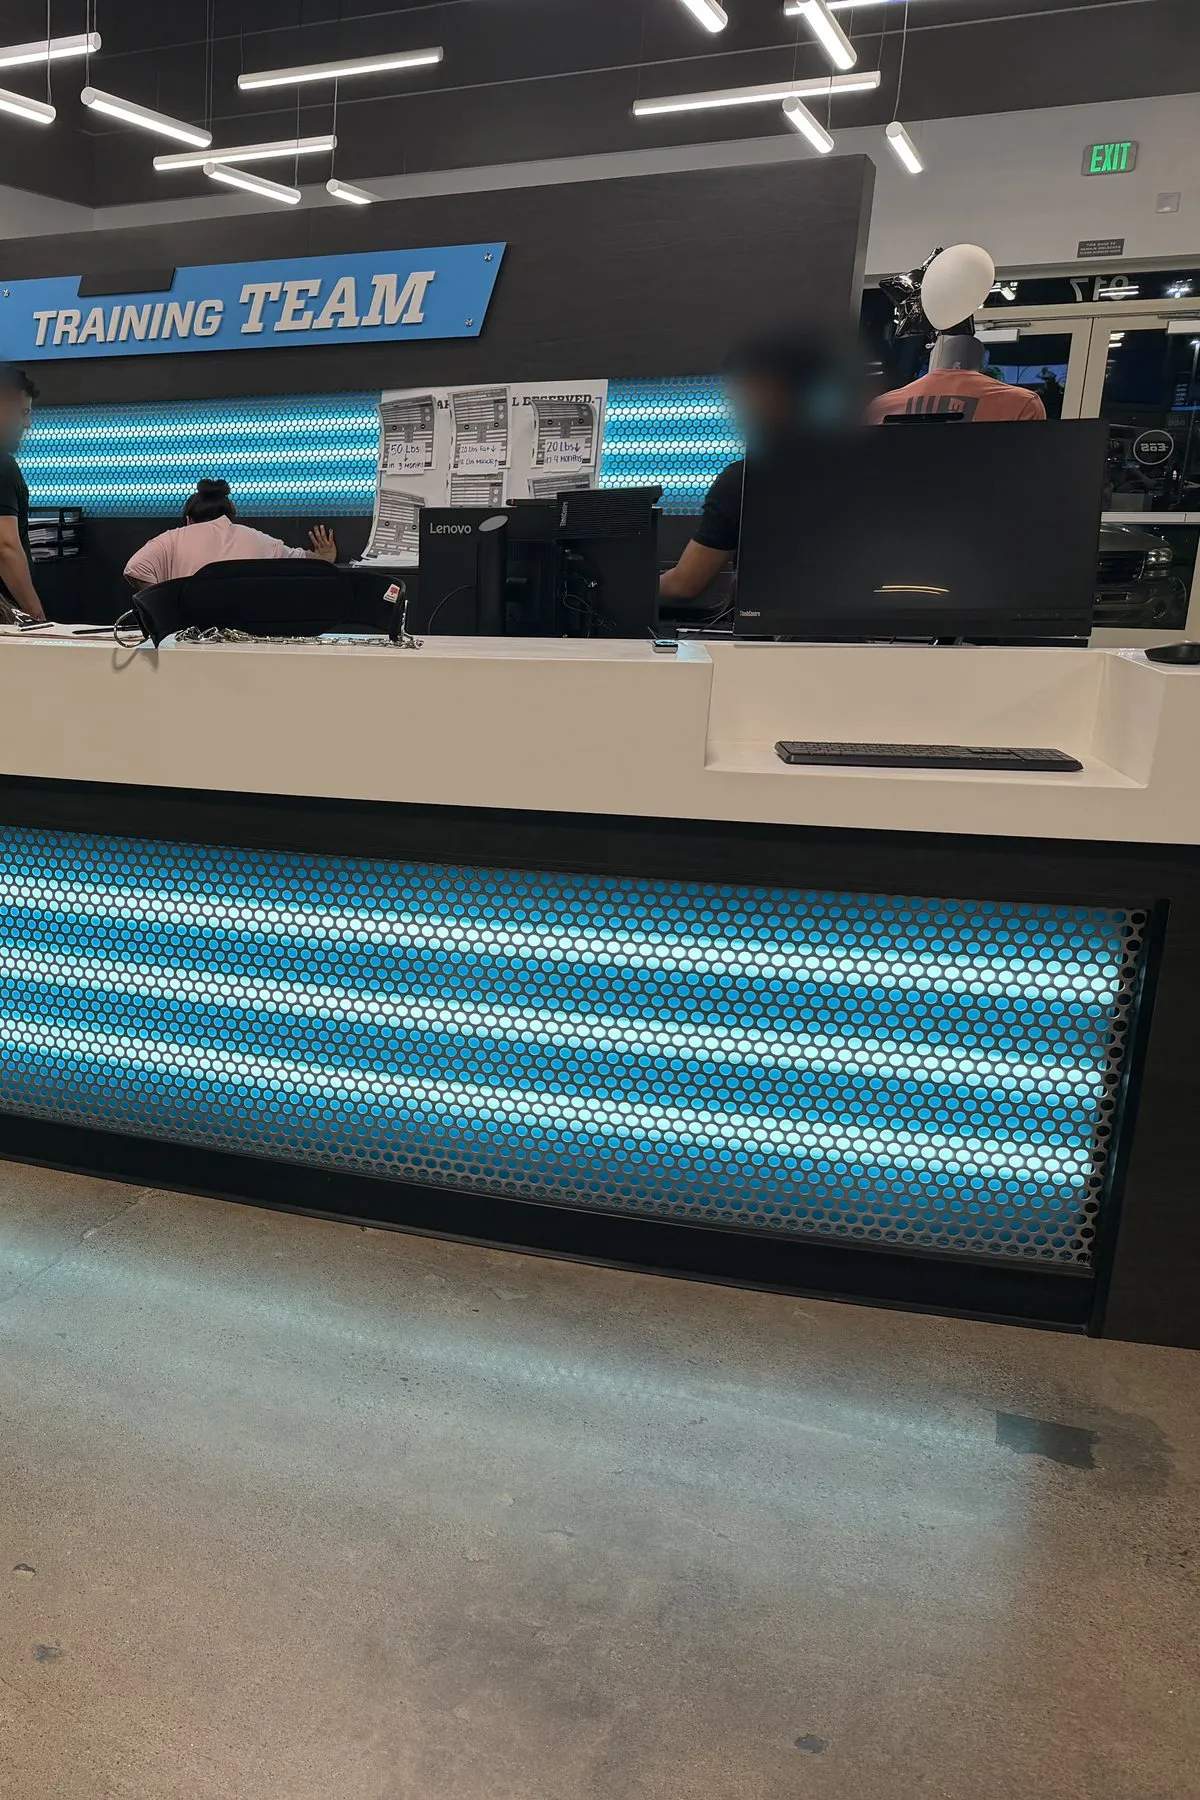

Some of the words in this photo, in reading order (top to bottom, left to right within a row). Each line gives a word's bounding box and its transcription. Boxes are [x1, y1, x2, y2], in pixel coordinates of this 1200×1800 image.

[1090, 143, 1131, 172] EXIT
[32, 300, 224, 346] TRAINING
[238, 270, 436, 333] TEAM
[390, 443, 403, 455] 50
[546, 441, 558, 453] 20
[429, 522, 472, 534] Lenovo
